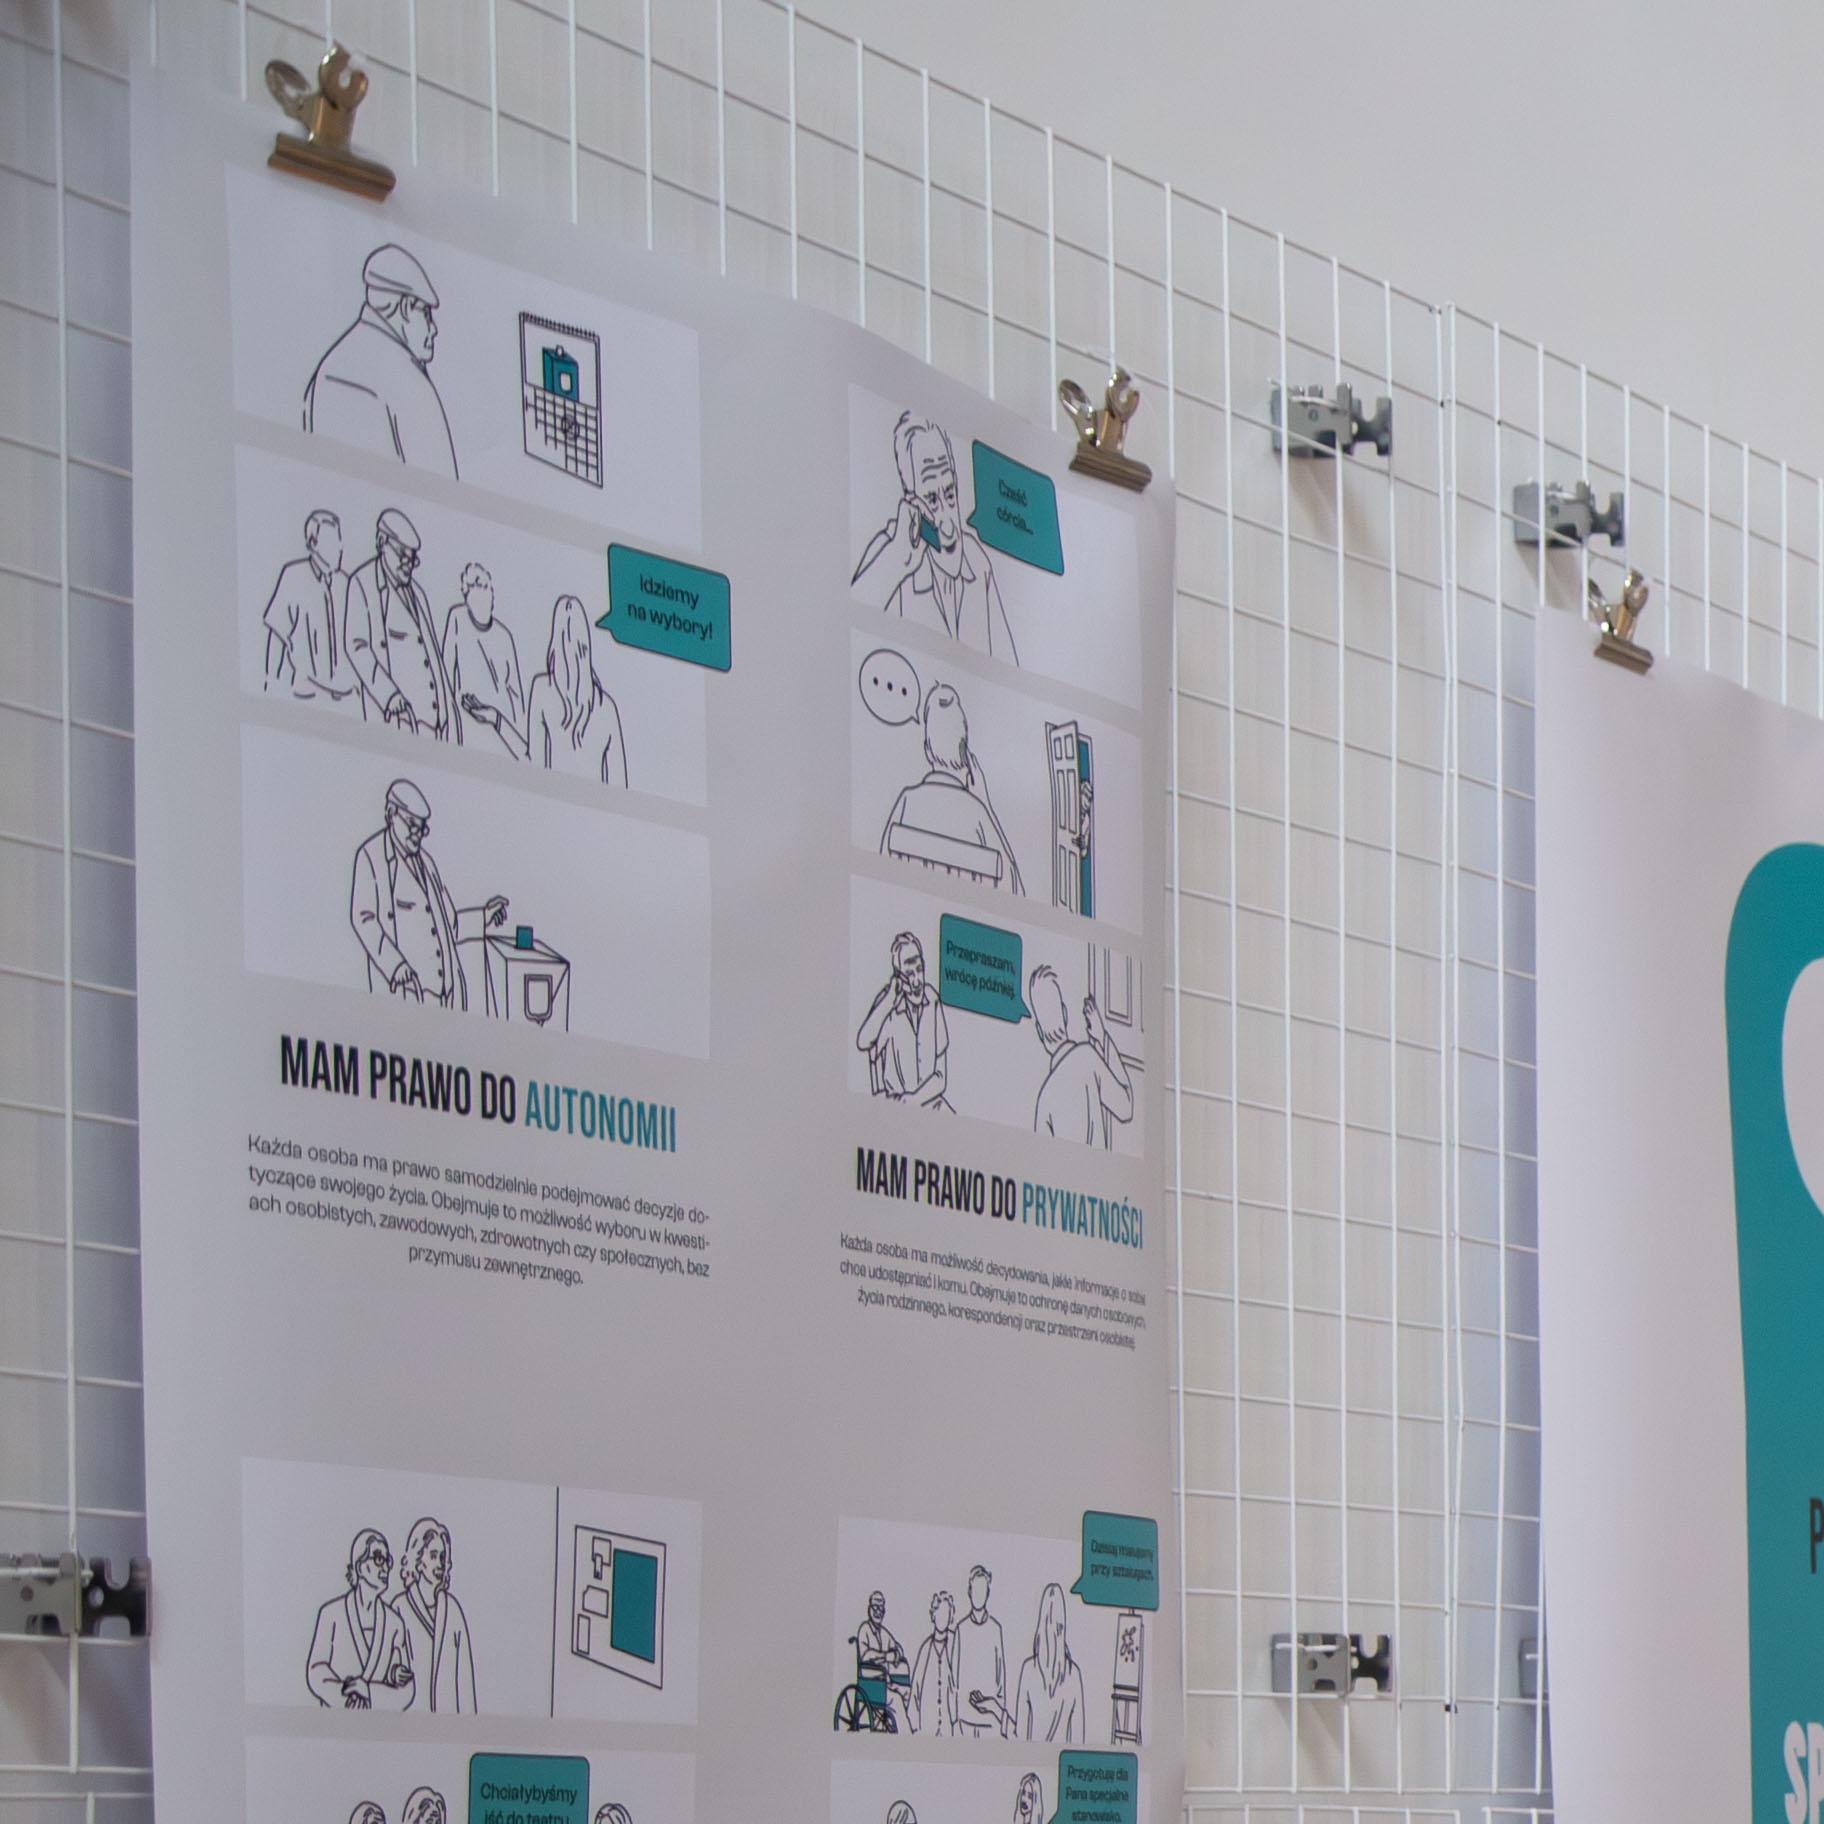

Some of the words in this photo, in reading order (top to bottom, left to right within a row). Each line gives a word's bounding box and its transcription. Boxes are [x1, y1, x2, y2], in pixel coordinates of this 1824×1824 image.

[640, 574, 699, 610] Idziemy
[628, 603, 646, 620] na
[649, 609, 712, 640] wybory!
[280, 1034, 359, 1097] MAM
[370, 1049, 471, 1115] PRAWO
[480, 1071, 516, 1124] DO
[525, 1080, 676, 1152] AUTONOMII
[249, 1134, 302, 1159] Każda
[308, 1147, 358, 1167] osoba
[364, 1155, 387, 1172] ma
[393, 1160, 440, 1180] prawo
[445, 1167, 537, 1196] samodzielnie
[542, 1183, 630, 1212] podejmować
[635, 1198, 684, 1222] decyzje
[689, 1206, 709, 1224] do-
[857, 1147, 907, 1200] MAM
[914, 1159, 984, 1215] PRAWO
[991, 1175, 1016, 1221] DO
[1022, 1182, 1143, 1250] PRYWATNOŚCI
[249, 1165, 316, 1190] tyczące
[321, 1178, 385, 1202] swojego
[389, 1184, 428, 1206] życia.
[432, 1190, 499, 1219] Obejmuje
[503, 1205, 517, 1220] to
[521, 1208, 592, 1232] możliwość
[595, 1220, 646, 1241] wyboru
[650, 1229, 660, 1243] w
[249, 1194, 281, 1213] ach
[286, 1199, 376, 1228] osobistych,
[380, 1213, 477, 1243] zawodowych,
[480, 1228, 570, 1257] zdrowotnych
[574, 1244, 596, 1263] czy
[600, 1247, 684, 1275] społecznych,
[688, 1259, 709, 1277] bez
[840, 1232, 872, 1253] Każda
[876, 1242, 907, 1260] osoba
[911, 1248, 928, 1263] ma
[409, 1246, 480, 1270] przymusu
[484, 1257, 583, 1287] zewnętrznego.
[840, 1259, 866, 1277] chce
[858, 1285, 885, 1306] życia
[480, 1782, 578, 1806] Chciałybyśmy
